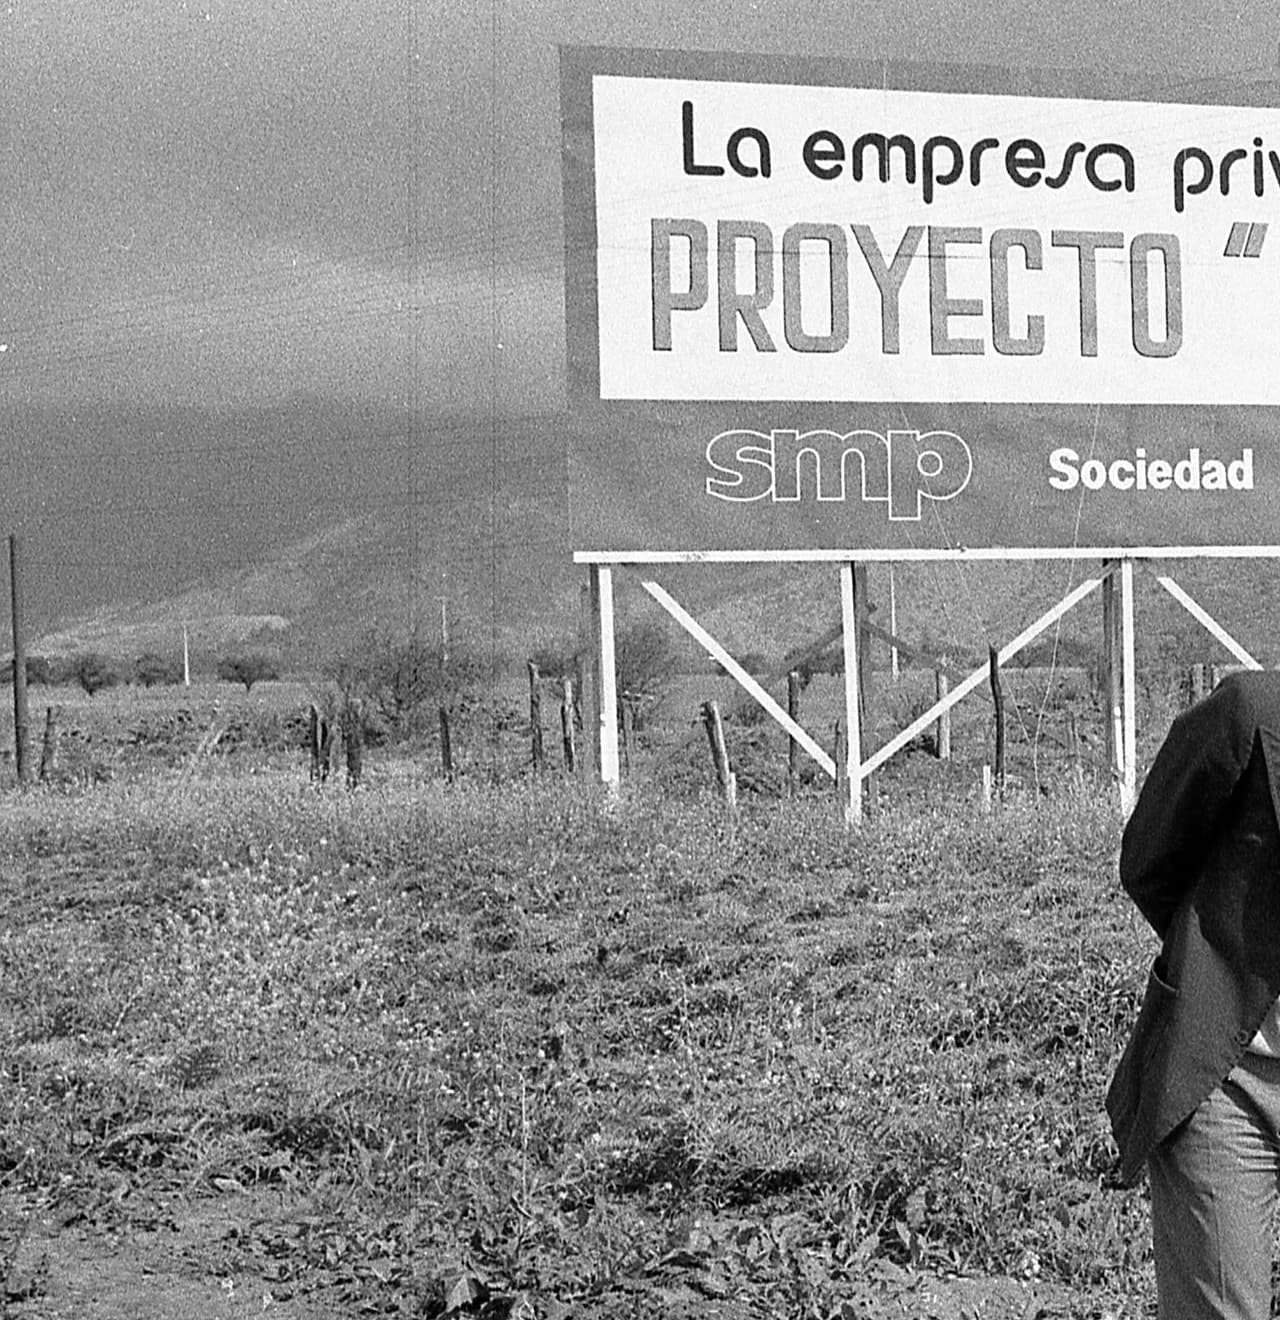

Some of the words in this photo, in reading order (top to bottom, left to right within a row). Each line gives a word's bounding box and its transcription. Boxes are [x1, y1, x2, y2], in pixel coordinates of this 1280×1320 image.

[682, 100, 771, 179] La
[802, 130, 1135, 204] empresa
[651, 217, 1185, 359] PROYECTO
[705, 429, 972, 520] smp
[1048, 448, 1253, 491] Sociedad
